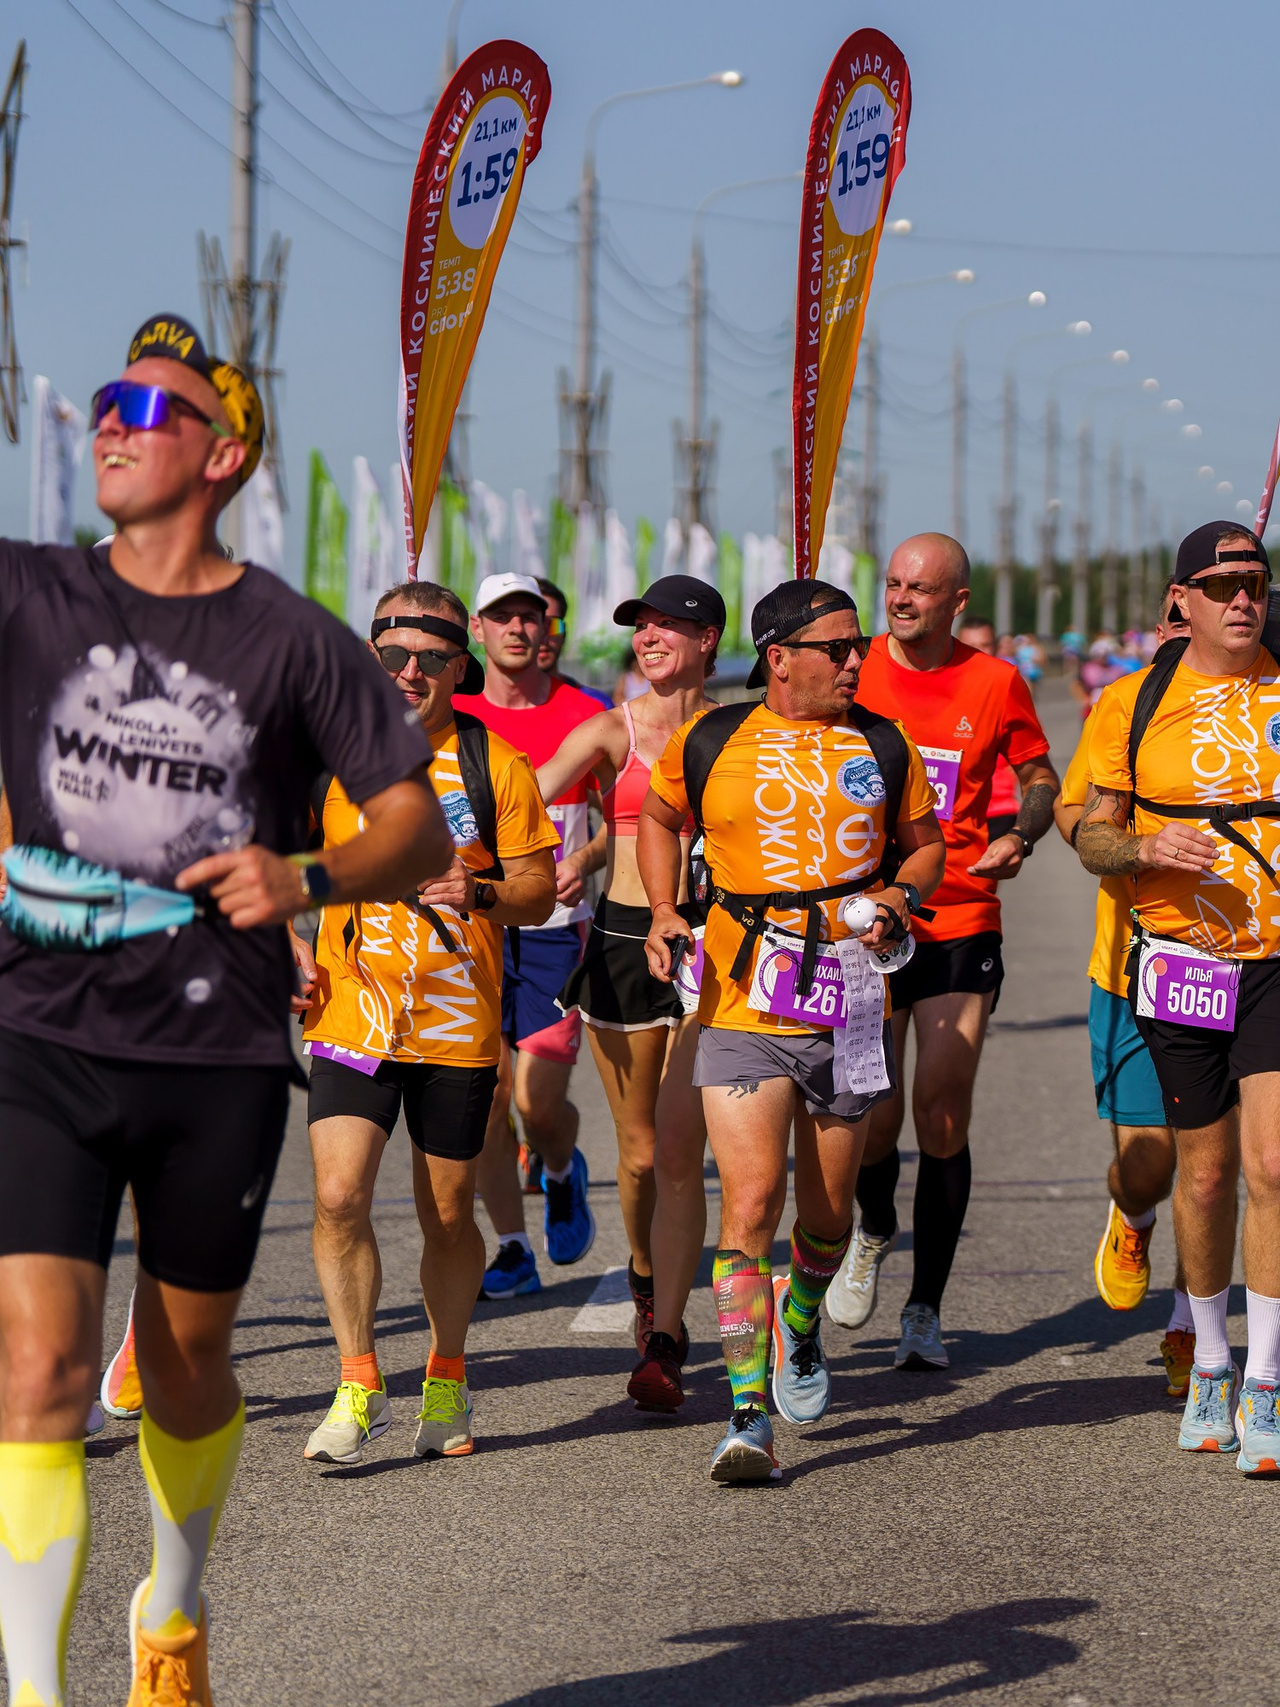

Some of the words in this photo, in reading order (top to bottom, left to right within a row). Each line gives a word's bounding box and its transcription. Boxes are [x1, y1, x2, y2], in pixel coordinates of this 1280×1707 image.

[474, 118, 499, 142] 21,1
[501, 117, 517, 134] КМ
[867, 104, 881, 121] КМ
[456, 147, 519, 207] 1:59
[408, 87, 476, 355] КОСМИЧЕСКИЙ
[808, 79, 846, 346] КОСМИЧЕСКИЙ
[439, 256, 461, 270] ТЕМП
[435, 267, 476, 300] 5:38
[54, 724, 228, 797] WINTER
[1190, 682, 1235, 887] КАЖСКИЙ
[755, 728, 803, 935] КЛУЖСКИЙ
[812, 964, 844, 983] ИХАИЛ
[1185, 966, 1213, 983] ИЛЬЯ
[1167, 982, 1227, 1020] 5050
